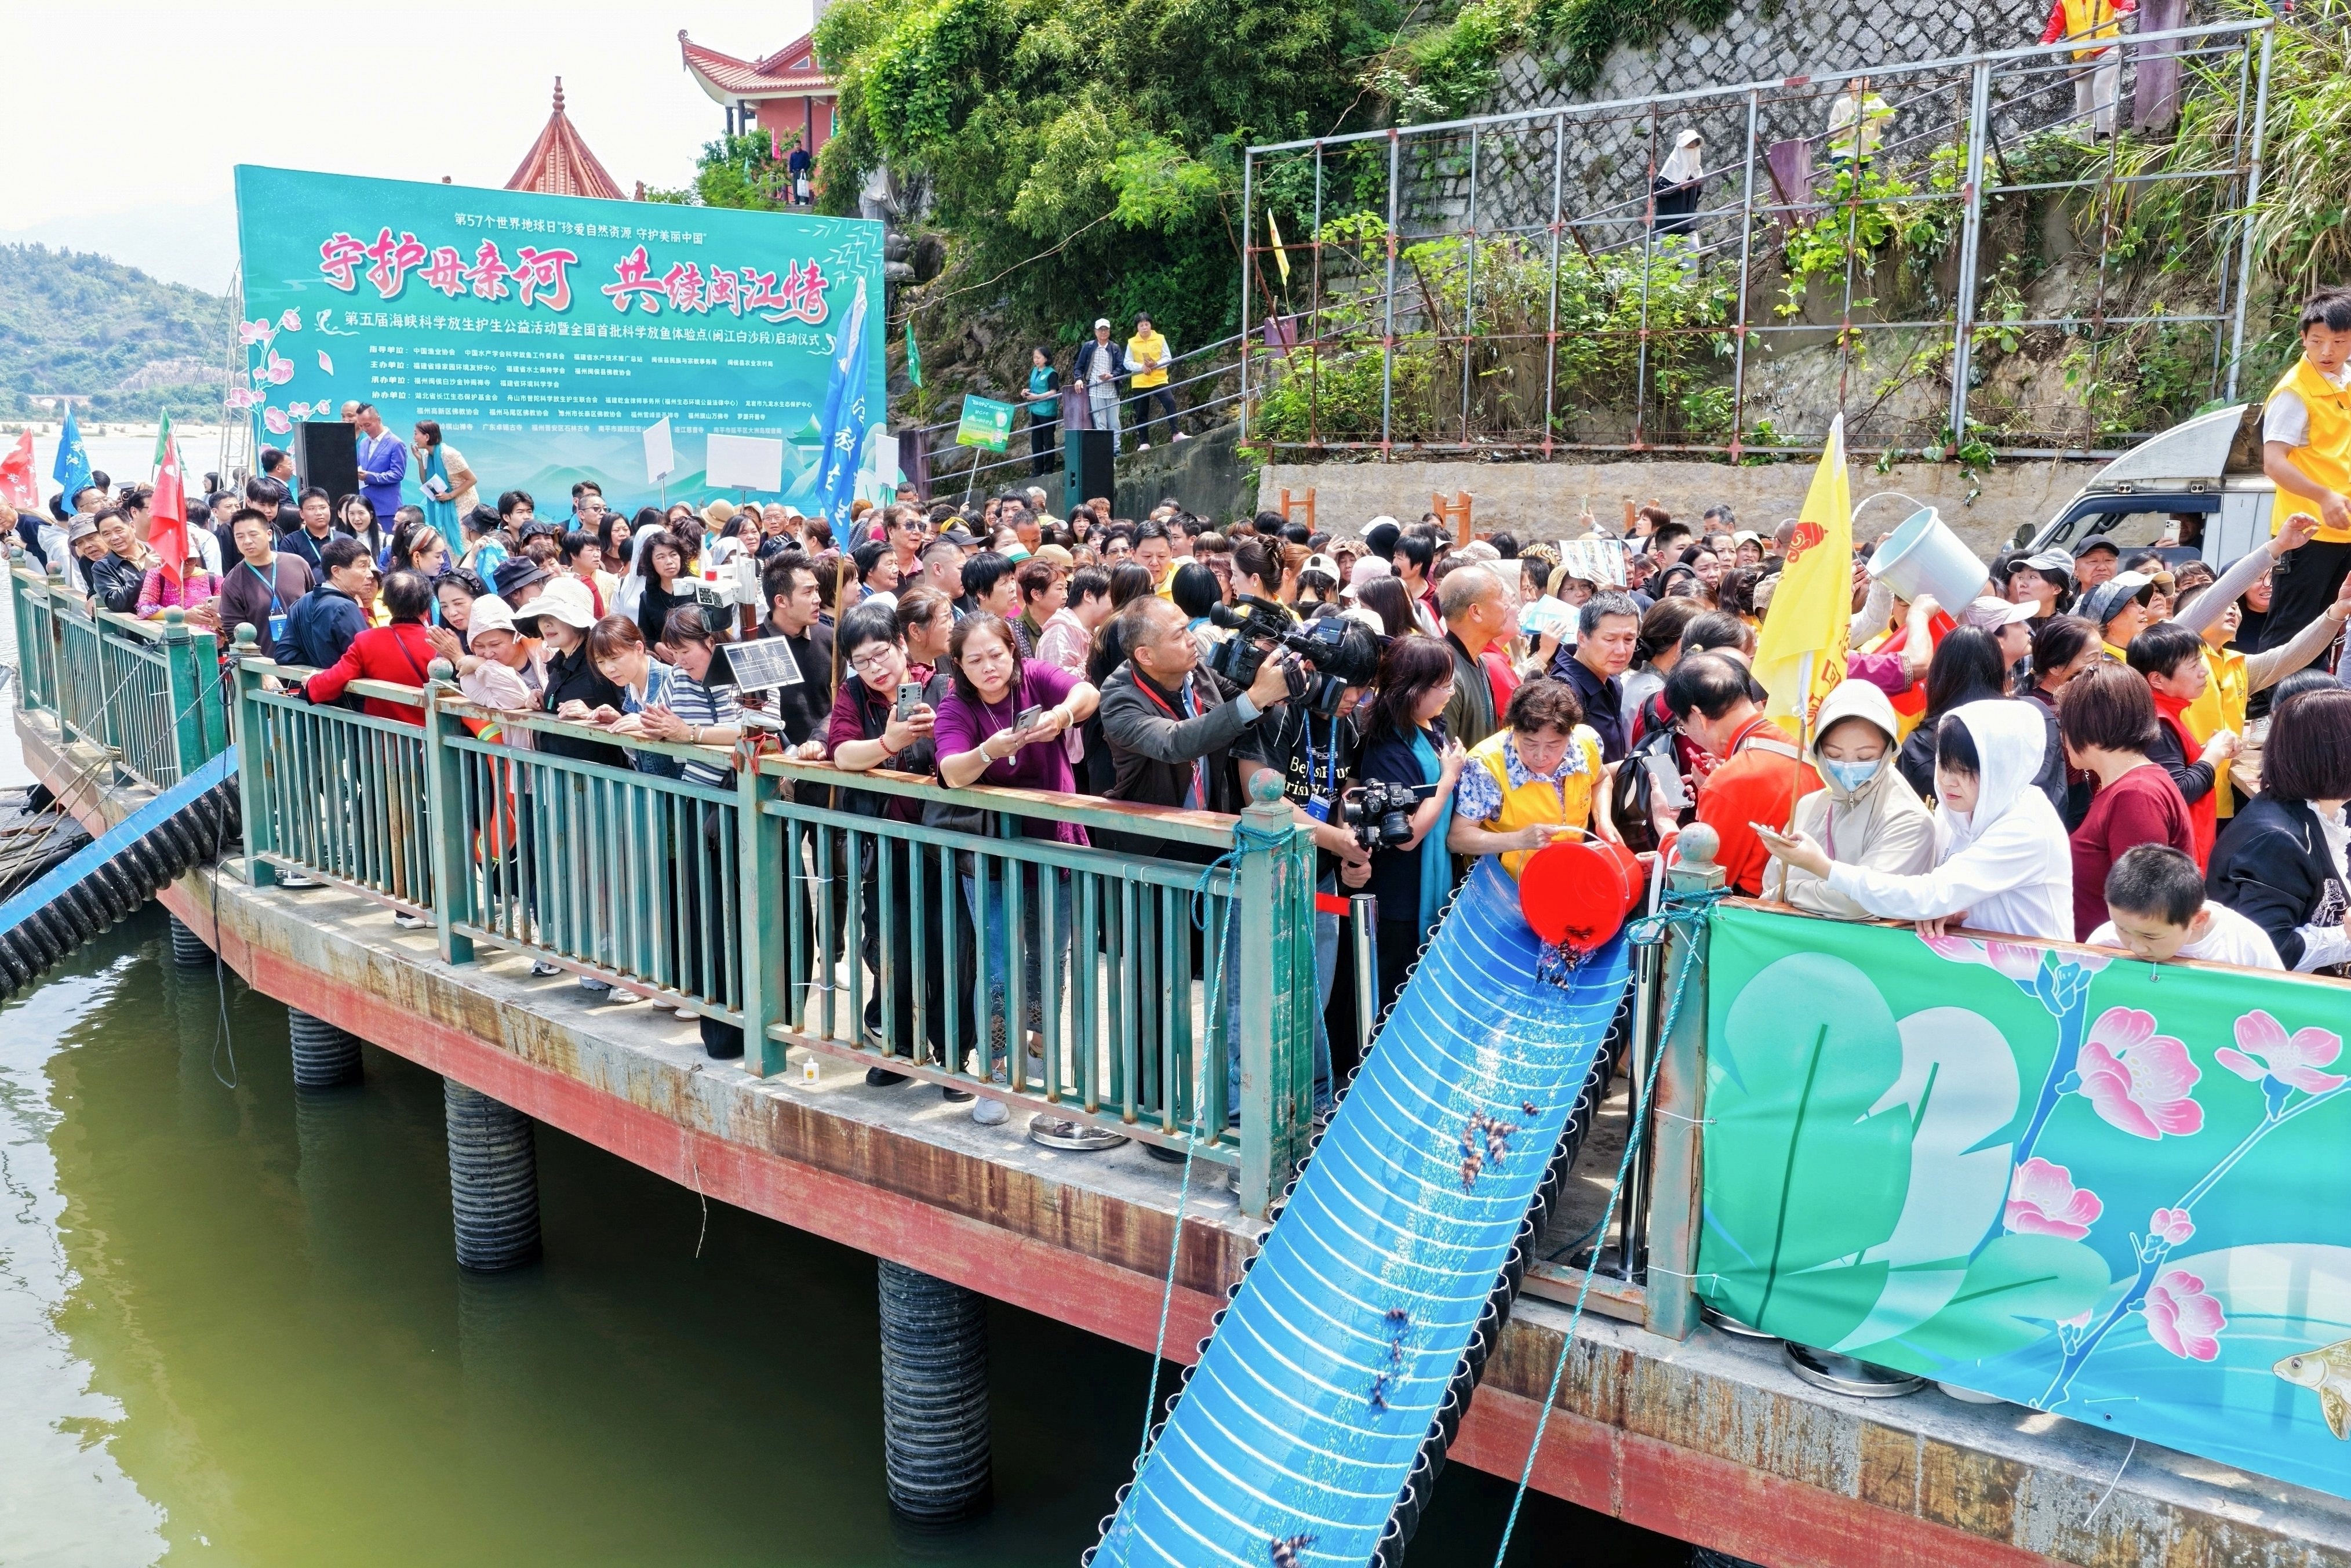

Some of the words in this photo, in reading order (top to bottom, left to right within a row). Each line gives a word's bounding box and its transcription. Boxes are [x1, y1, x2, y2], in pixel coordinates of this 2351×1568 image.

[319, 227, 578, 311] 守护母亲河
[601, 244, 829, 324] 共续闽江情
[413, 347, 455, 356] 中国渔业协会
[464, 350, 565, 360] 中国水产学会科学放鱼工作委员会
[574, 354, 643, 363] 福建省水产技术推广总站
[413, 362, 497, 372] 福建省绿家园环境友好中心
[506, 366, 565, 374] 福建省水土保持学会
[575, 368, 631, 376] 福州闽侯县佛教协会
[500, 380, 559, 388] 福建省环境科学学会
[415, 392, 498, 401] 湖北省长江生态保护基金会
[507, 394, 598, 403] 舟山市普陀科学放生护生联合会
[416, 407, 479, 416] 福州高新区佛教协会
[489, 408, 549, 417] 福州马尾区佛教协会
